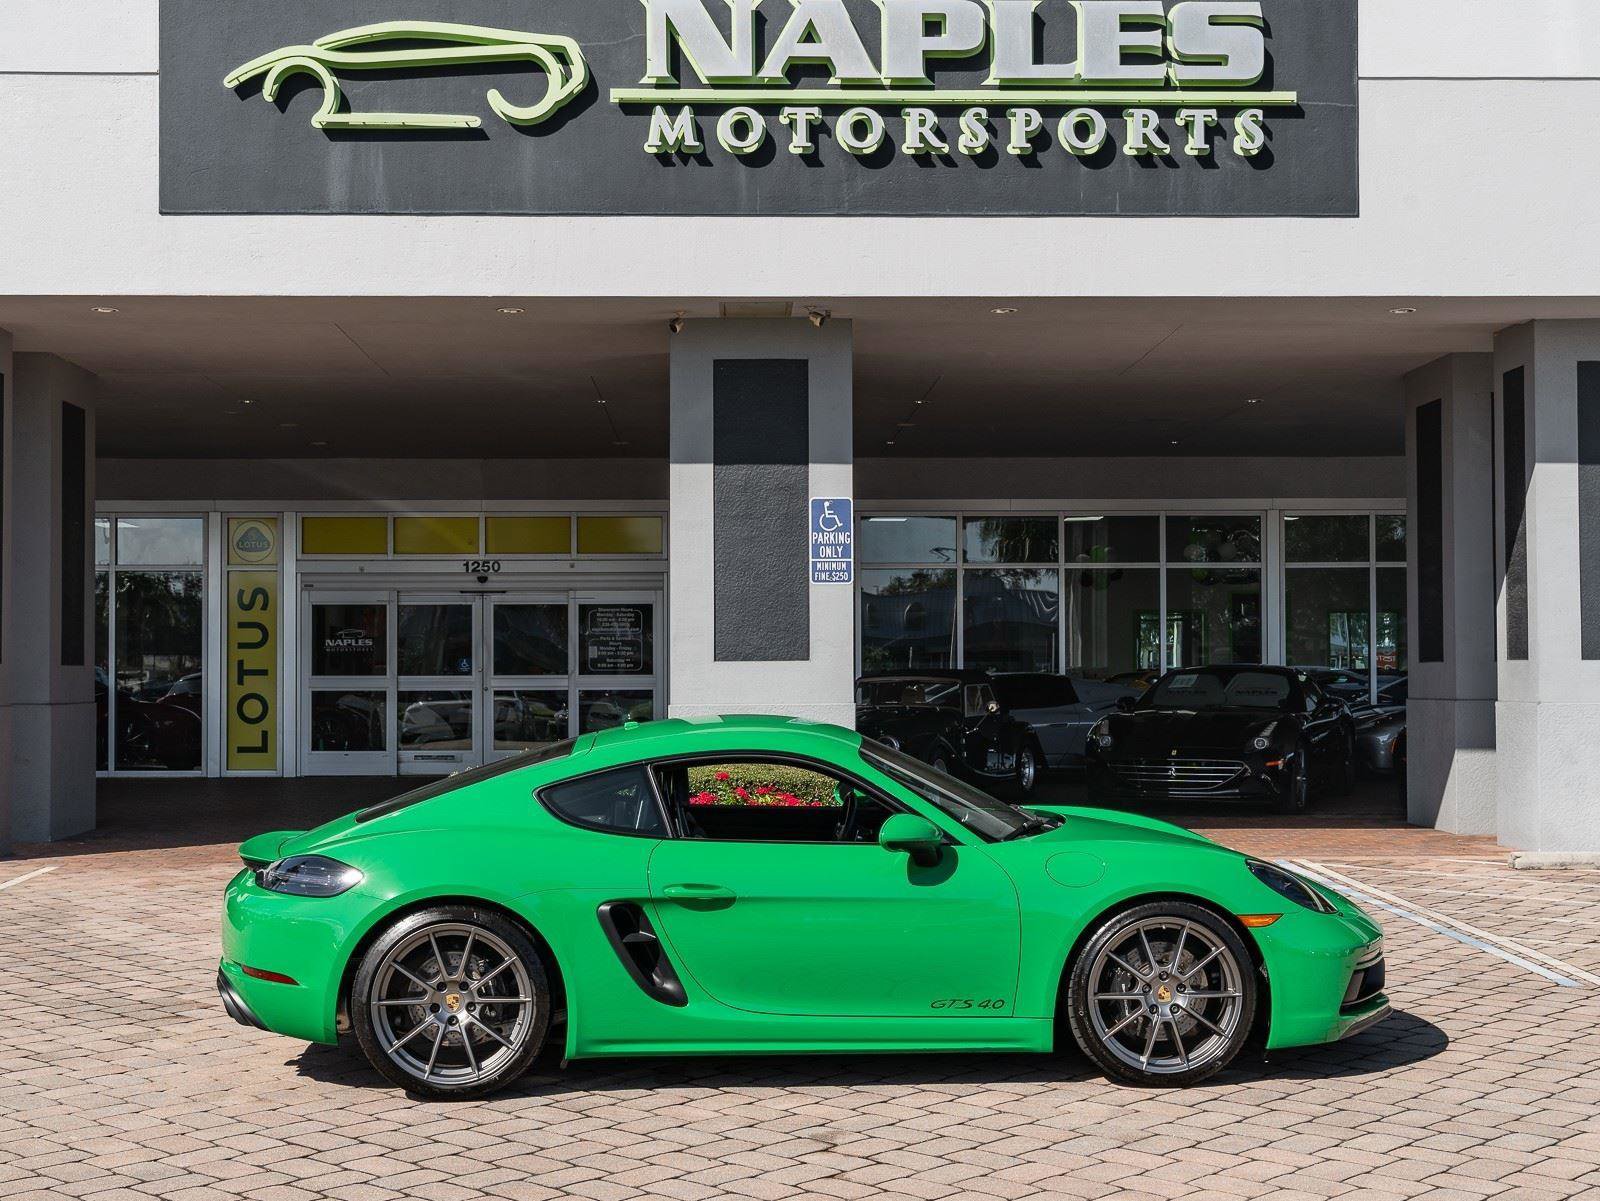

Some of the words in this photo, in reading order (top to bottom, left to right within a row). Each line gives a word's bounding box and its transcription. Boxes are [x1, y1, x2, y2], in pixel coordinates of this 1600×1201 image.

[639, 0, 1265, 86] NAPLES
[644, 105, 1265, 155] MOTORSPORTS
[812, 532, 851, 544] PARKING
[239, 540, 269, 549] LOTUS
[819, 546, 844, 558] ONLY
[463, 560, 501, 573] 1250
[816, 562, 847, 571] MINIMUM
[814, 572, 830, 581] FINE
[832, 572, 849, 581] $250
[236, 586, 269, 754] LOTUS
[930, 999, 974, 1009] GTS
